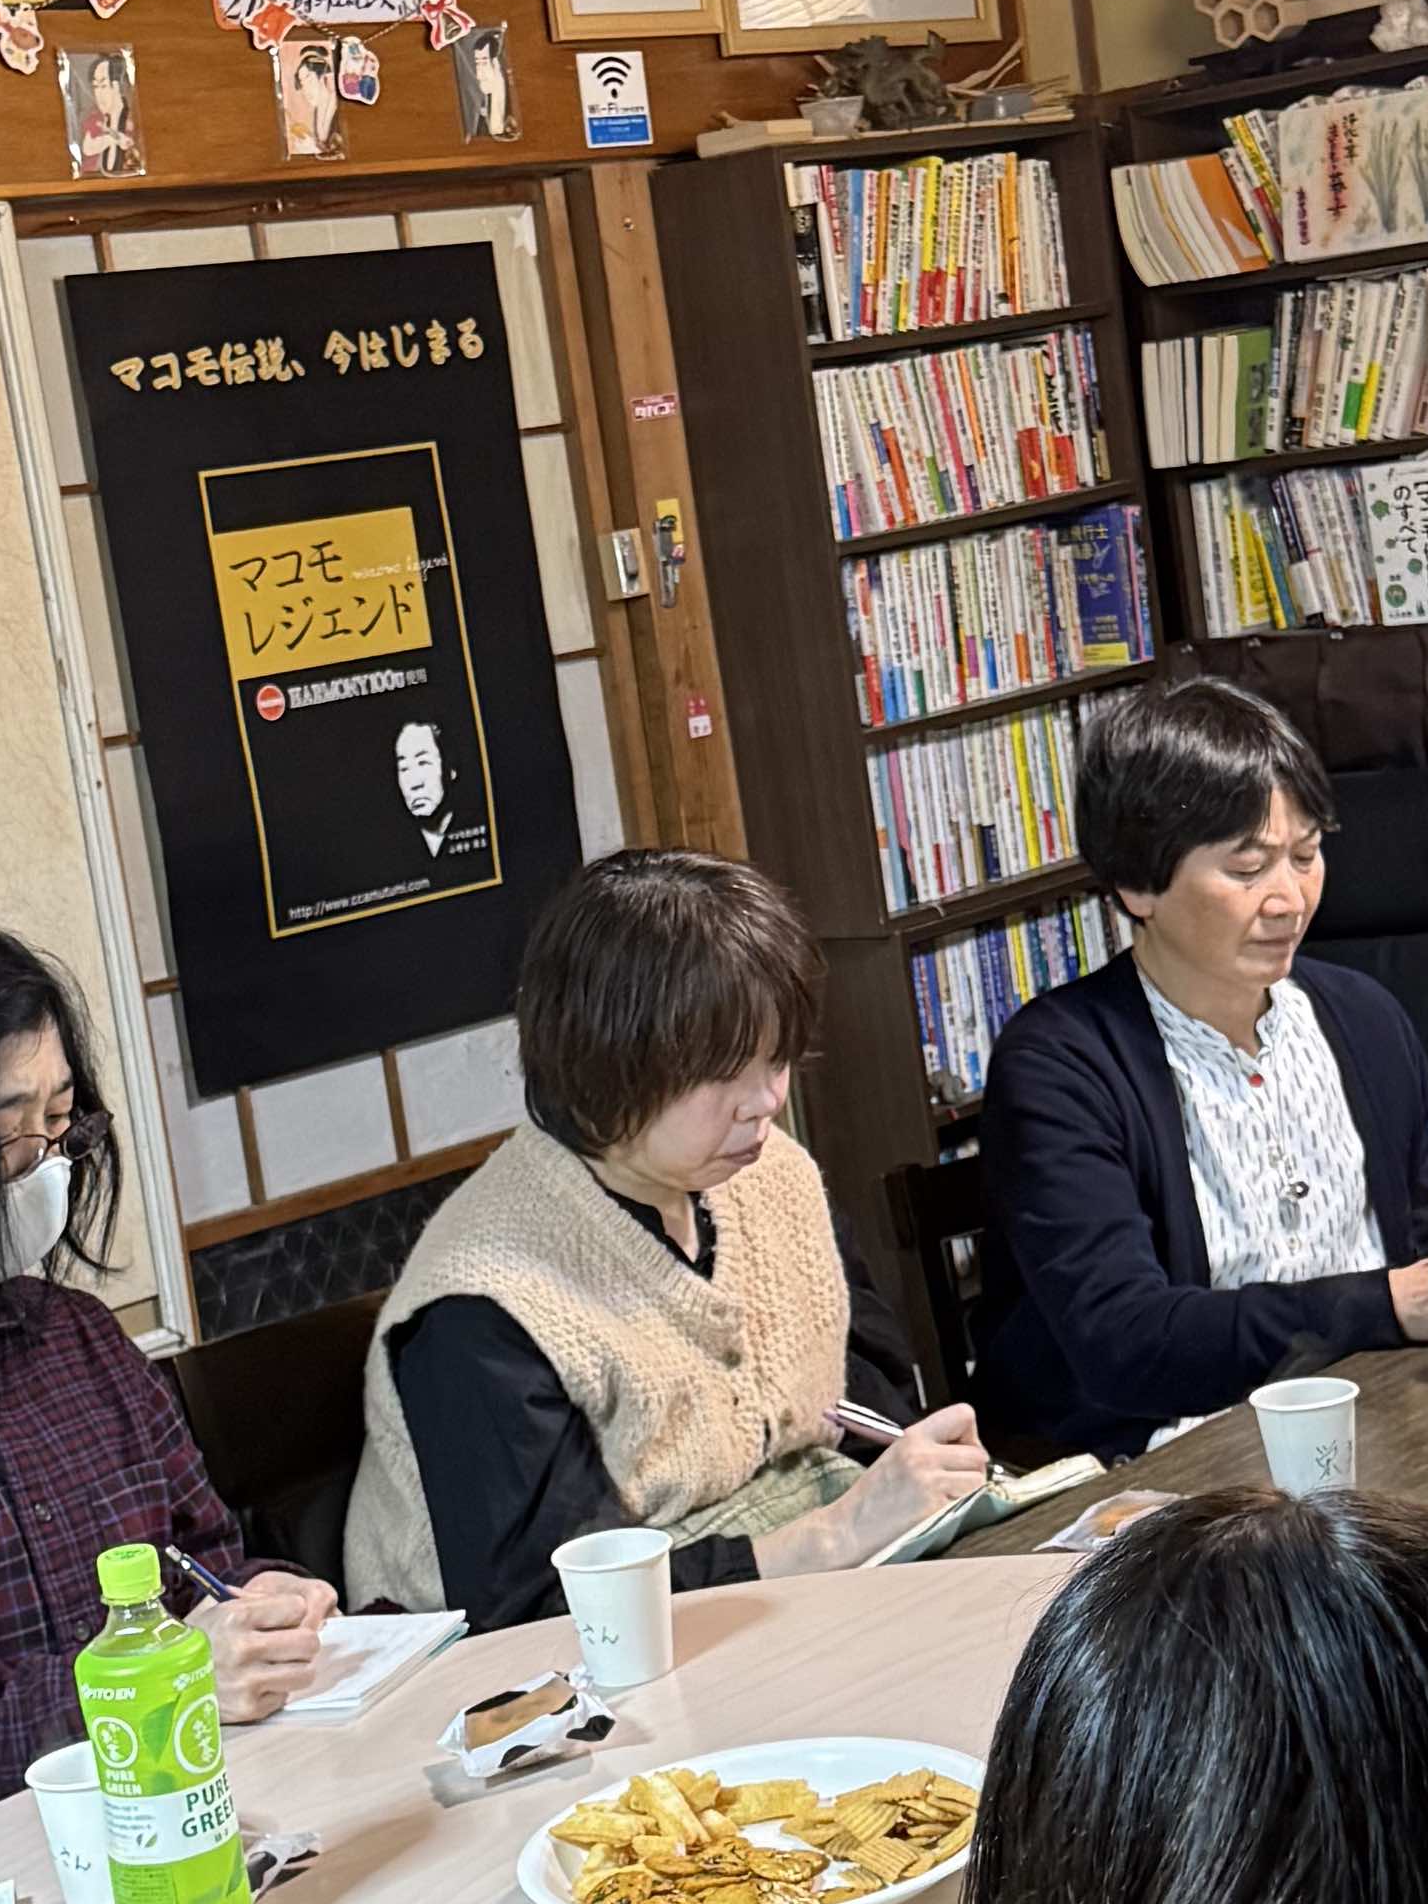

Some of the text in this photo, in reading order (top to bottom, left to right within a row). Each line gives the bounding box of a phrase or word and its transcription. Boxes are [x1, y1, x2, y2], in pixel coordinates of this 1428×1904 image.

[323, 317, 485, 376] 今はじまる
[229, 540, 344, 592] マコモ
[244, 581, 416, 657] レジェンド
[105, 1769, 136, 1783] PURE
[105, 1781, 142, 1796] GREEN
[185, 1771, 230, 1813] PURE
